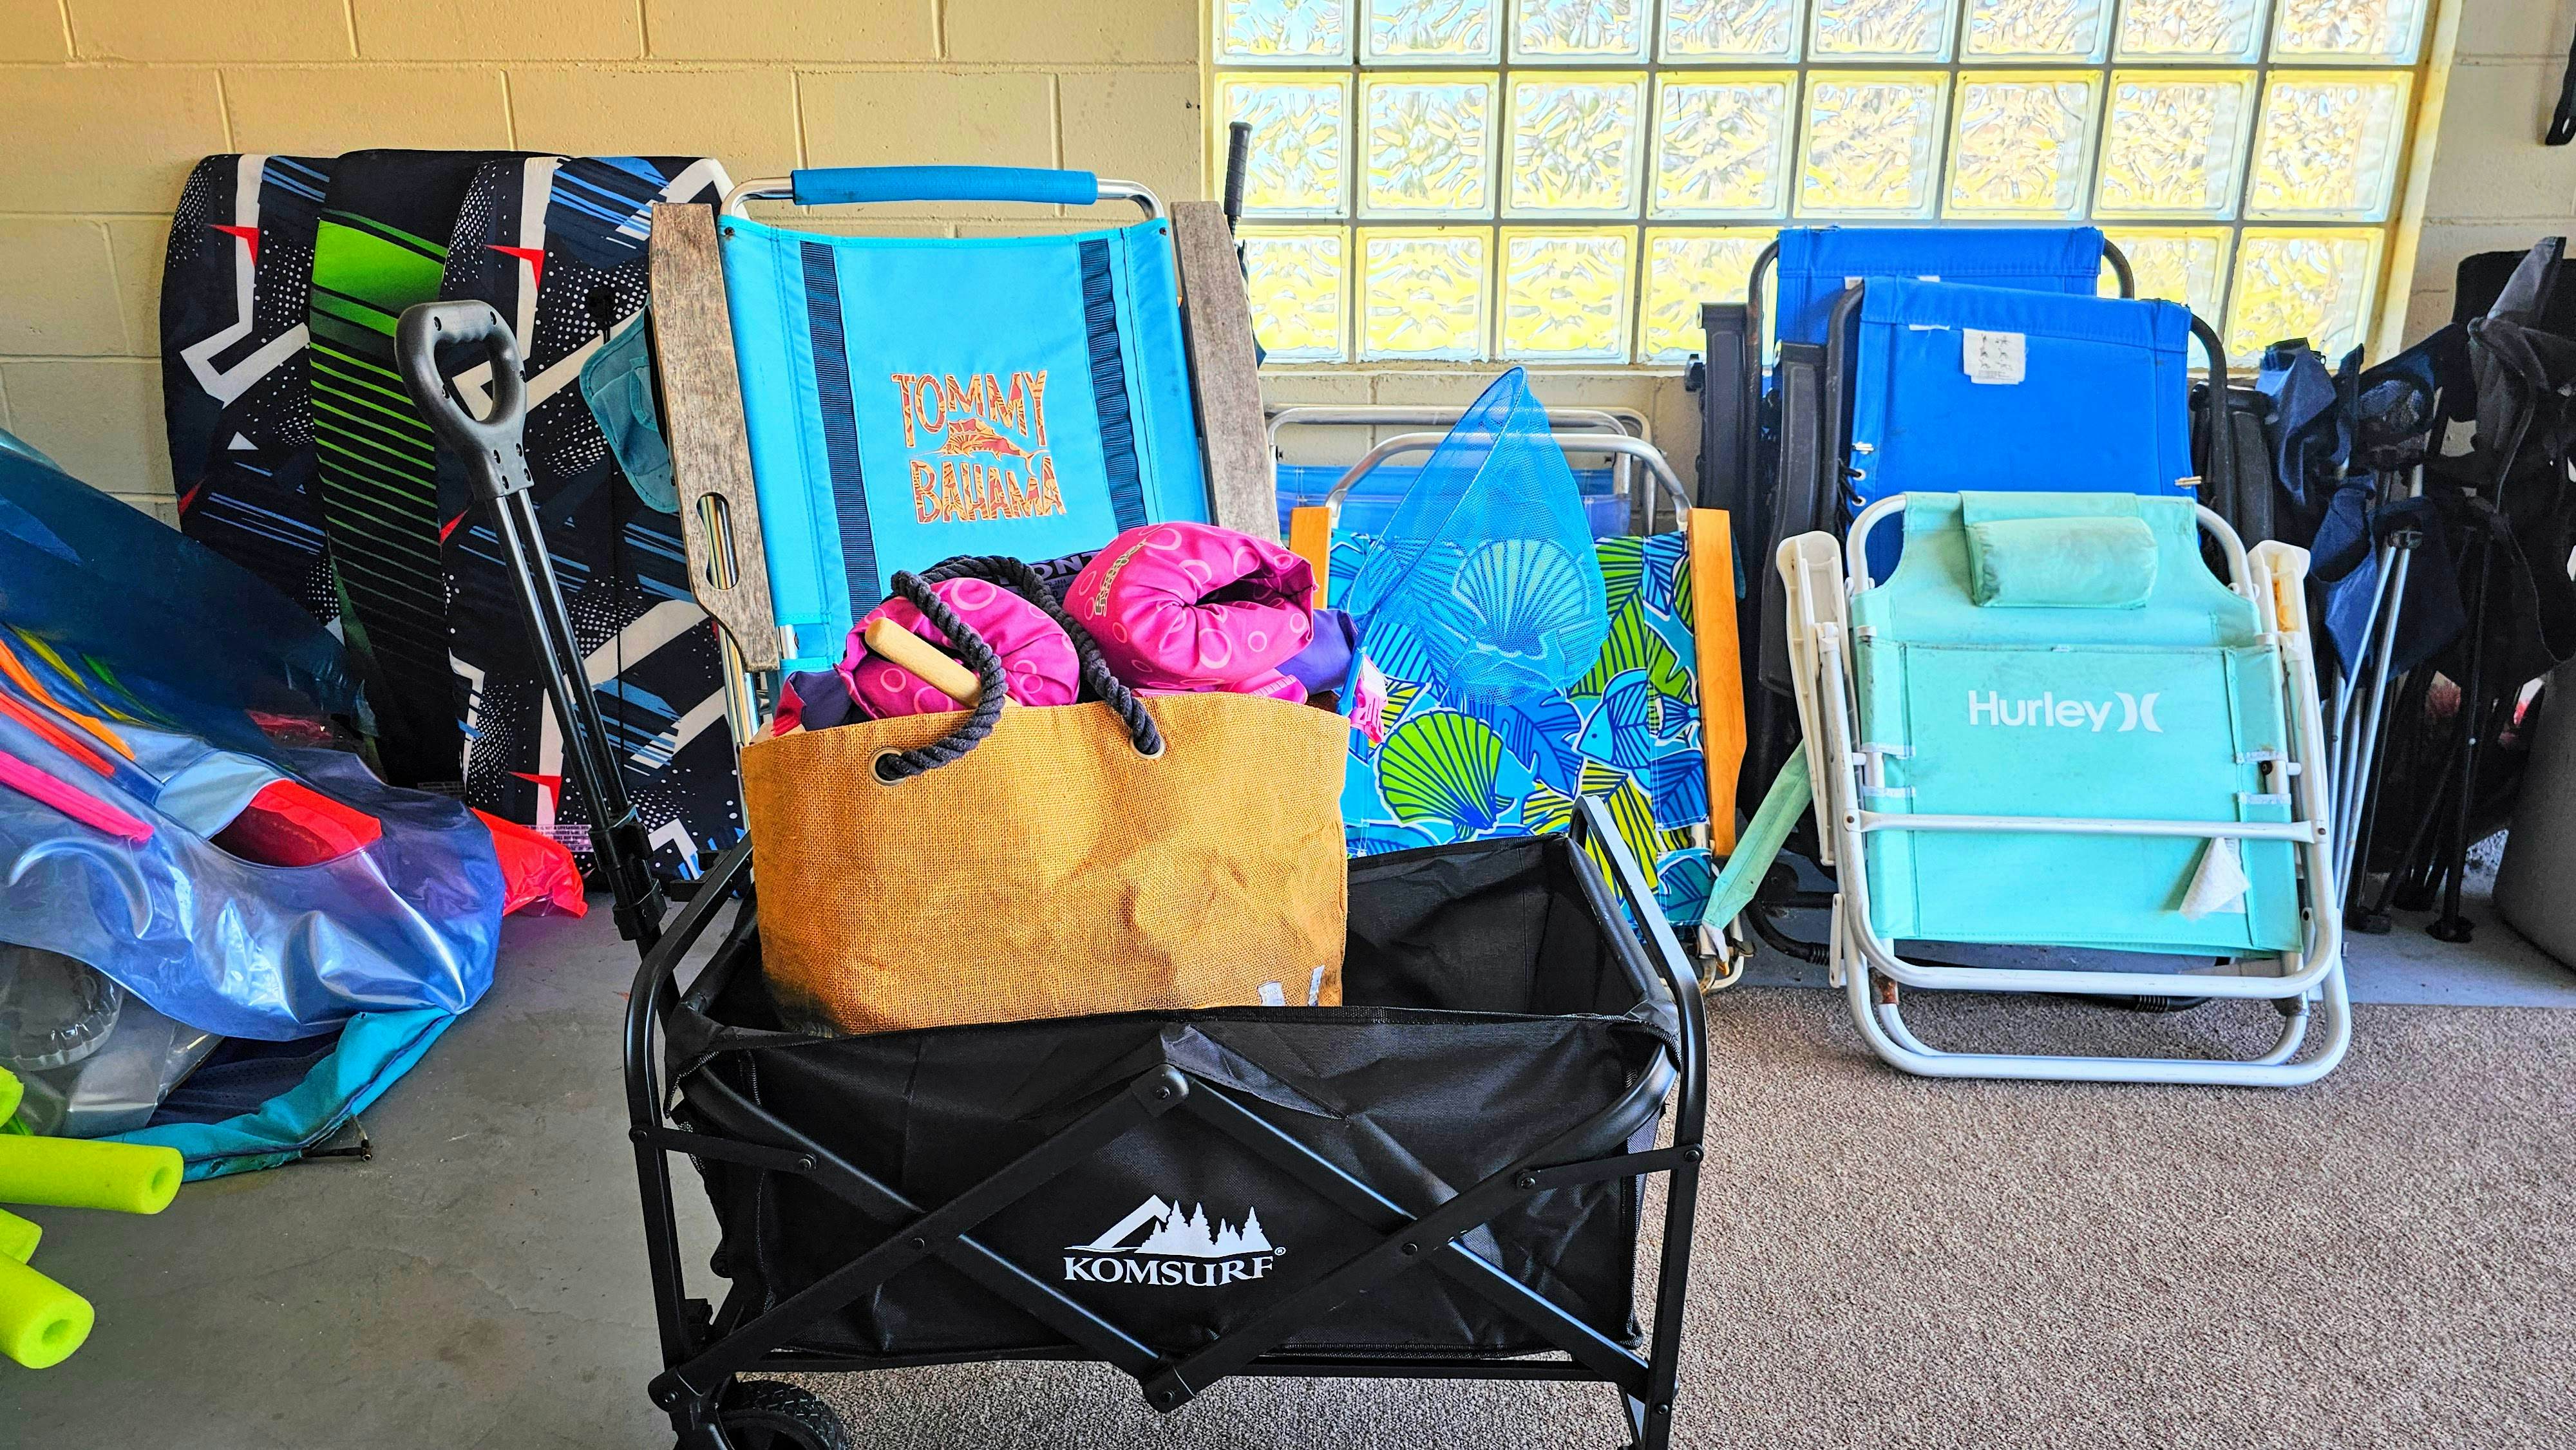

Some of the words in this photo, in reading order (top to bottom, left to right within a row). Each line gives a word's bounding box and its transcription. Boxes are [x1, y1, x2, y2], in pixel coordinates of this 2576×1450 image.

[891, 370, 1048, 448] TOMMY
[909, 456, 1067, 525] BAHAMA
[1968, 690, 2113, 732] Hurley
[1063, 1255, 1274, 1287] KOMSURF
